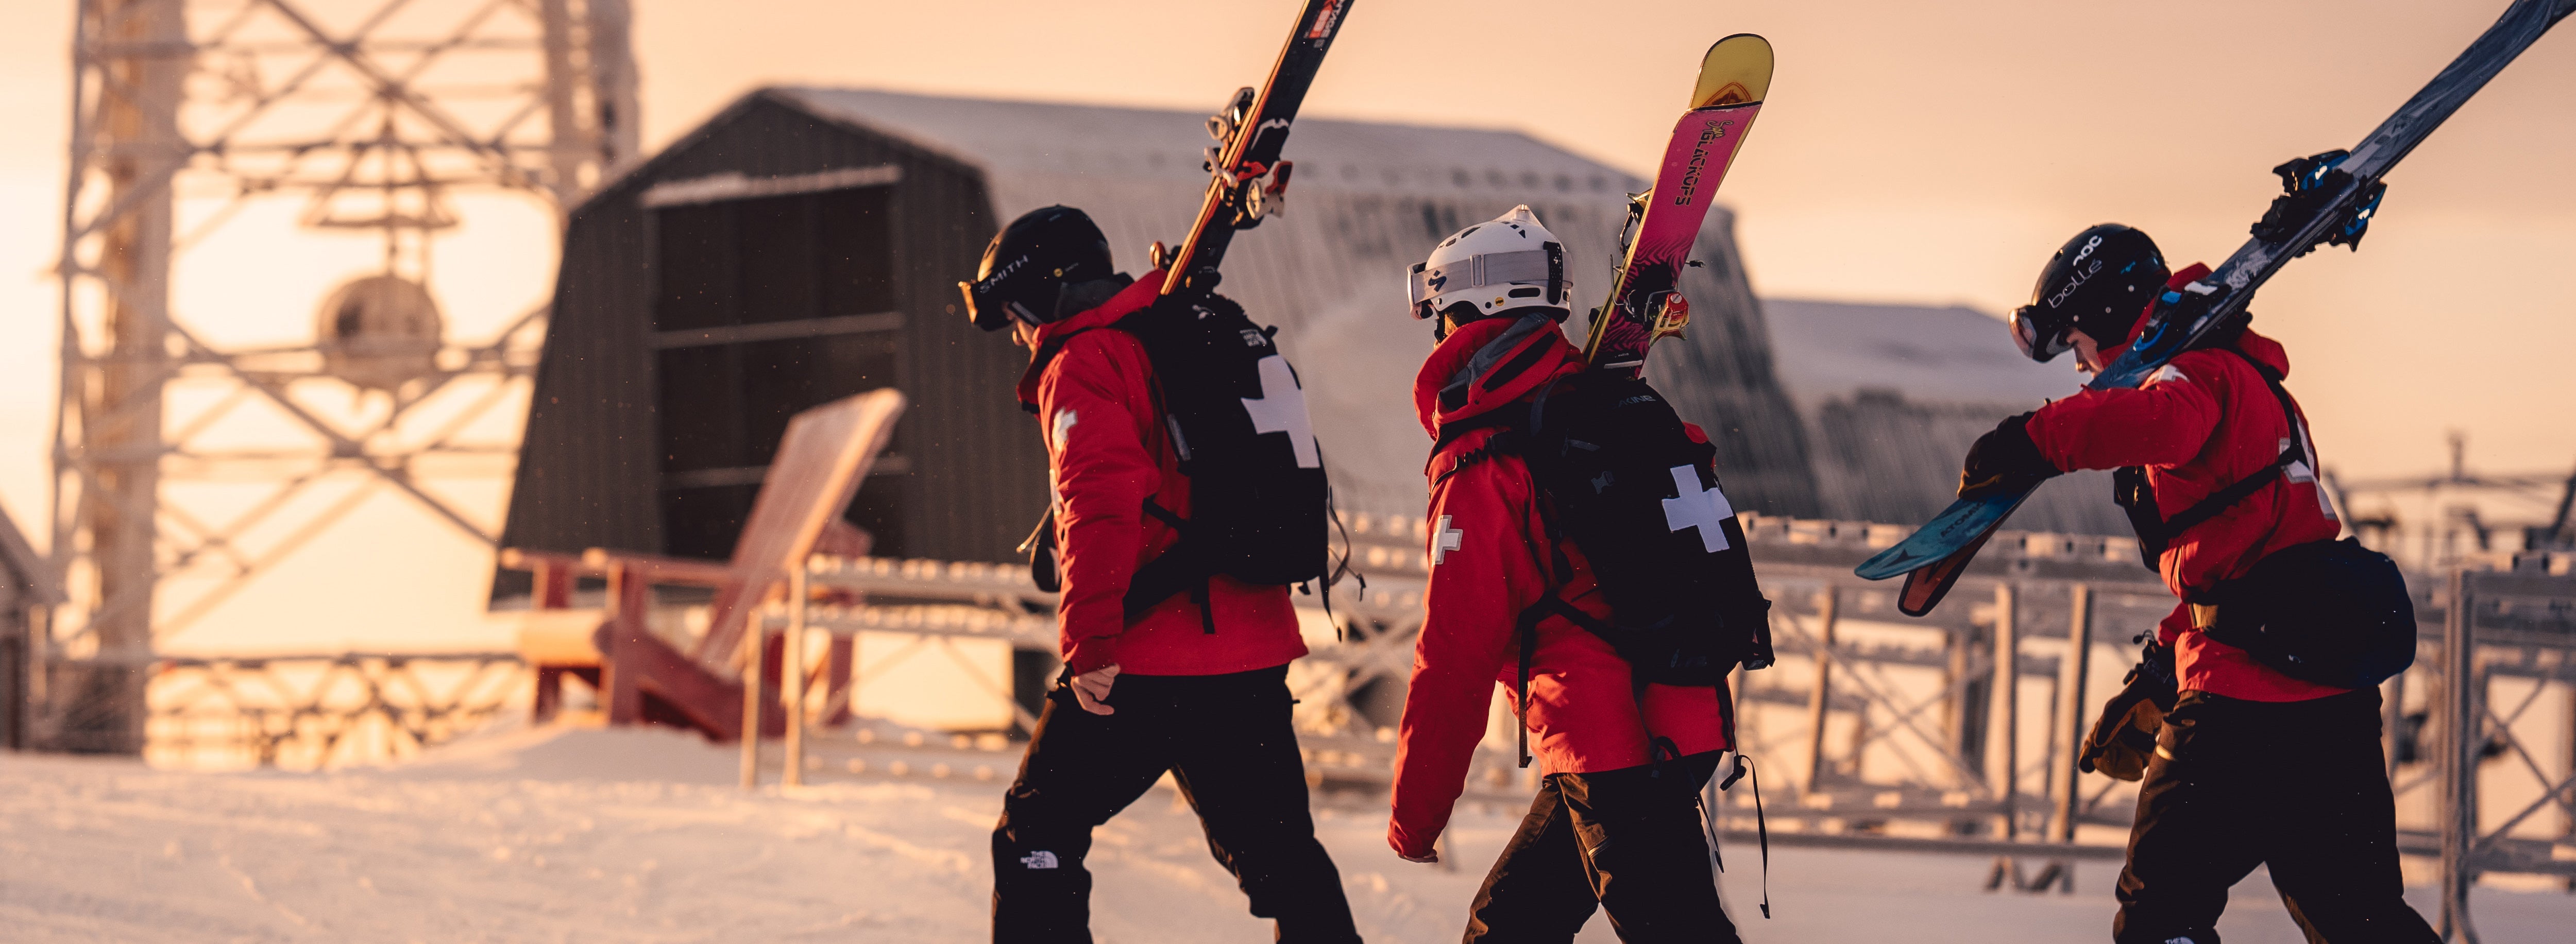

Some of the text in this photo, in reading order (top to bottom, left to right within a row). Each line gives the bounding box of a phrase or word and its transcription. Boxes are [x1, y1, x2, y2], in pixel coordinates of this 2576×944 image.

[979, 254, 1028, 294] SMITH
[1614, 394, 1657, 407] AKINE
[1940, 499, 1987, 538] ATOMIC
